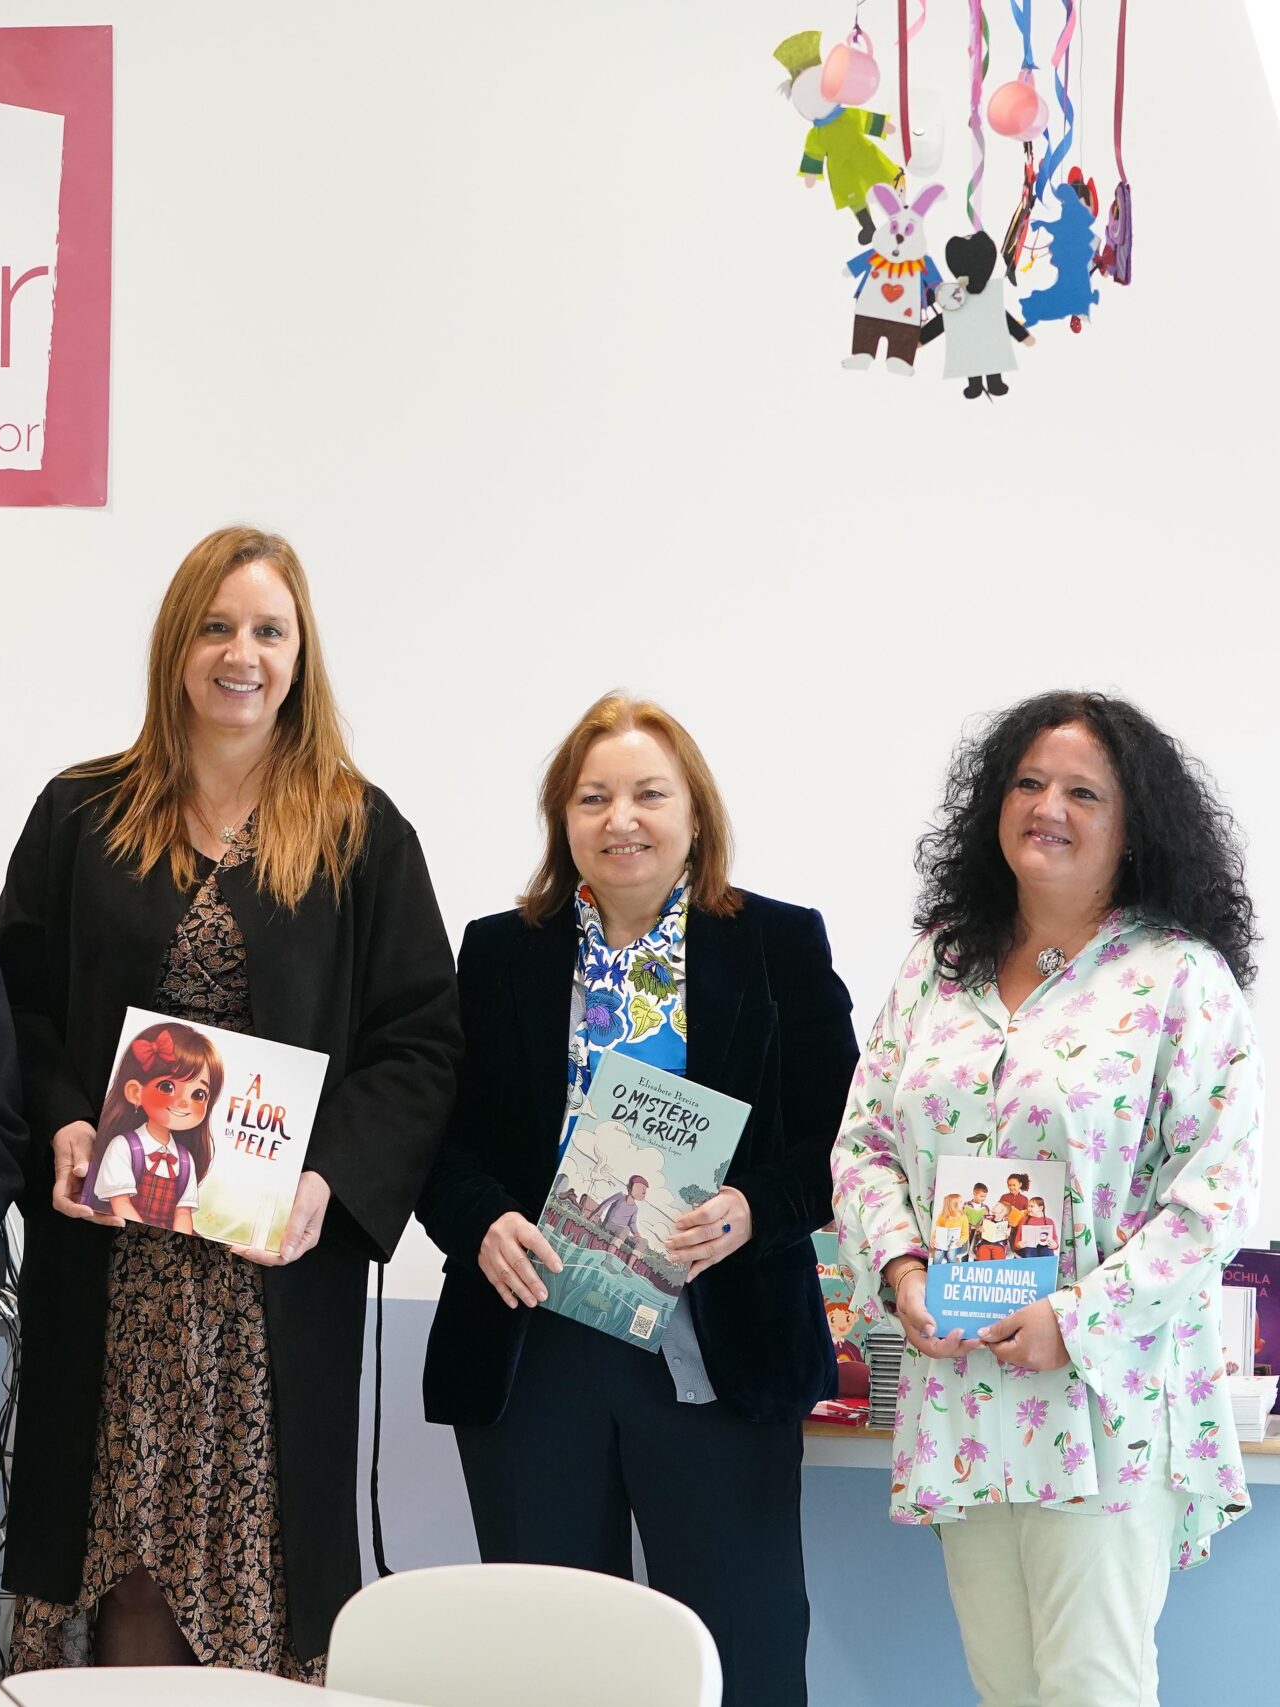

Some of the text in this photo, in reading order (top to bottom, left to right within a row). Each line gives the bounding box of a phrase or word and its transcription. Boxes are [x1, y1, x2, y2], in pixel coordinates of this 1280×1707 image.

[638, 1076, 699, 1107] Elisabete Pereira
[227, 1096, 291, 1140] FLOR
[612, 1084, 710, 1131] O MISTÉRIO
[611, 1103, 698, 1152] DA GRUTA
[235, 1131, 282, 1161] PELE
[951, 1265, 1038, 1288] PLANO ANUAL
[943, 1283, 1037, 1305] DE ATIVIDADES
